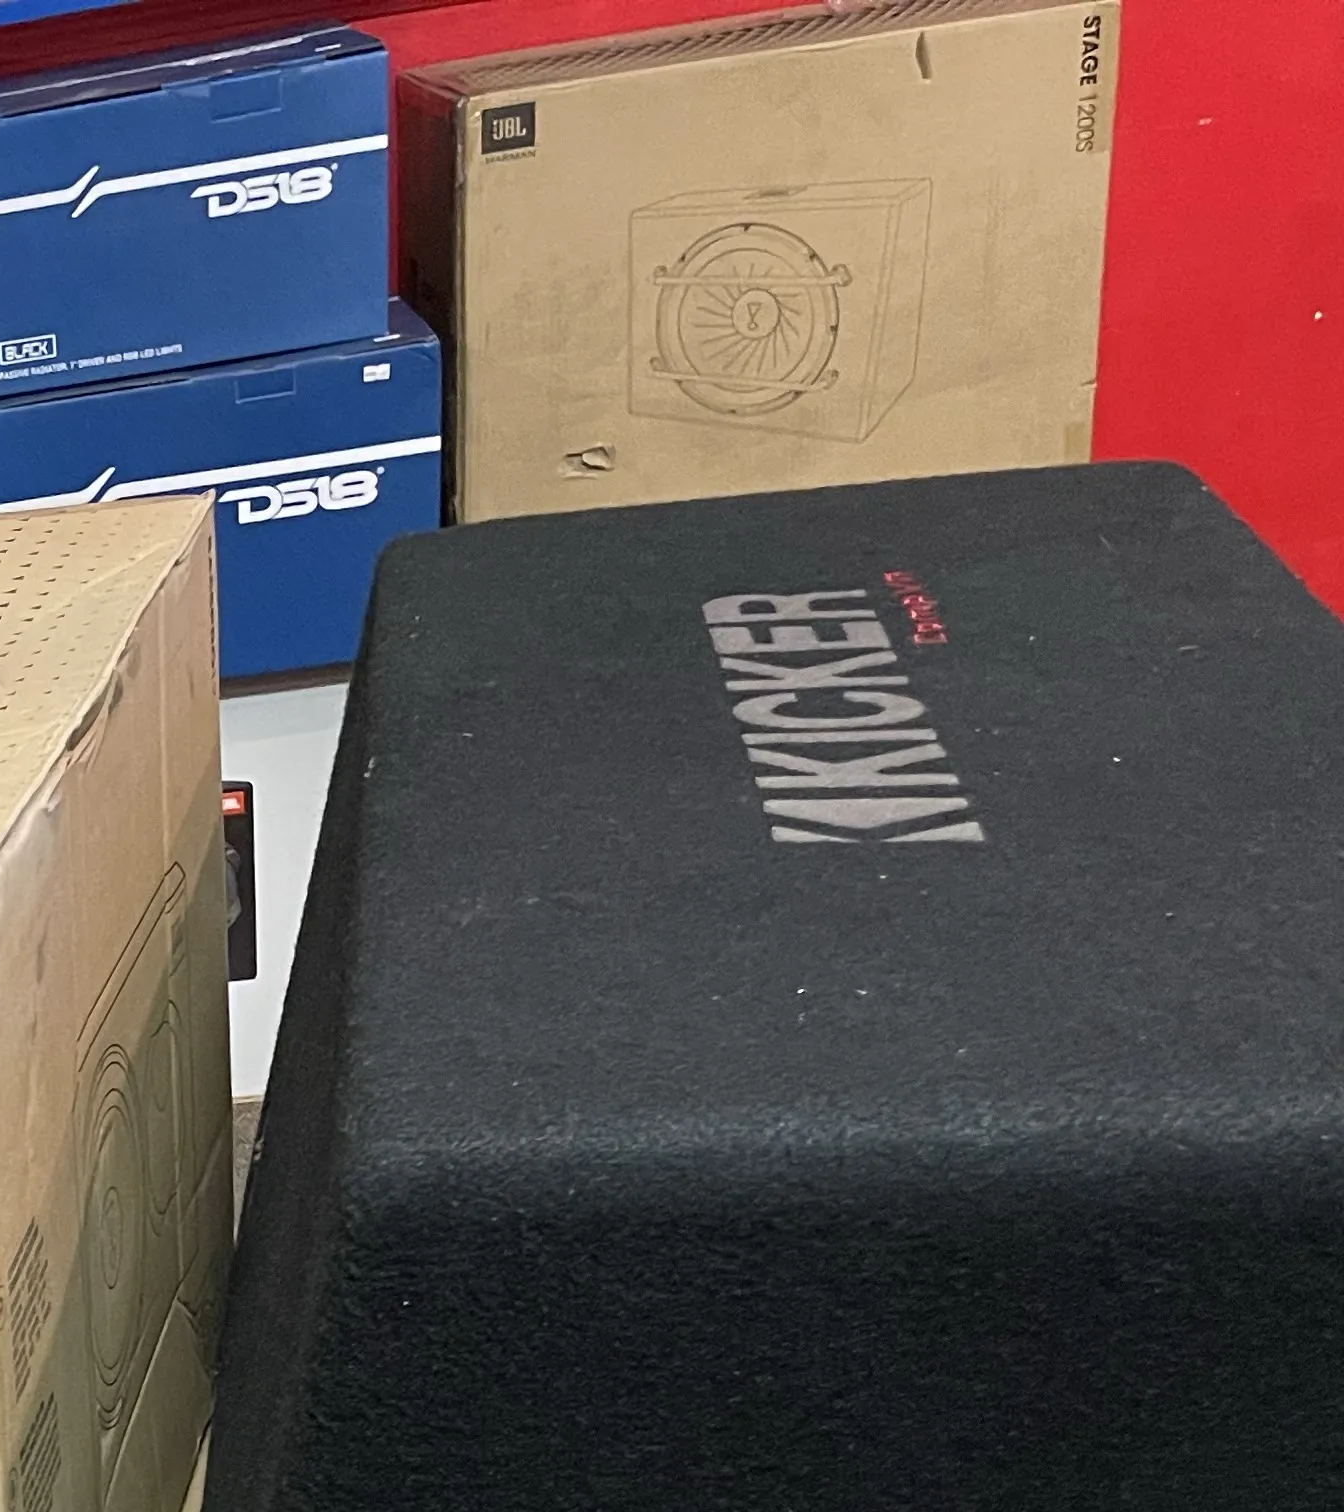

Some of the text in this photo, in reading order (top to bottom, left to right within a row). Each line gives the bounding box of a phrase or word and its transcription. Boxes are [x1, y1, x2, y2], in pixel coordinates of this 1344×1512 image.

[1075, 15, 1101, 152] STAGE 1200S
[493, 116, 527, 140] JBL
[190, 166, 333, 218] DS18
[4, 341, 48, 361] BLACK
[218, 470, 379, 525] DS18
[702, 588, 960, 790] KICKER
